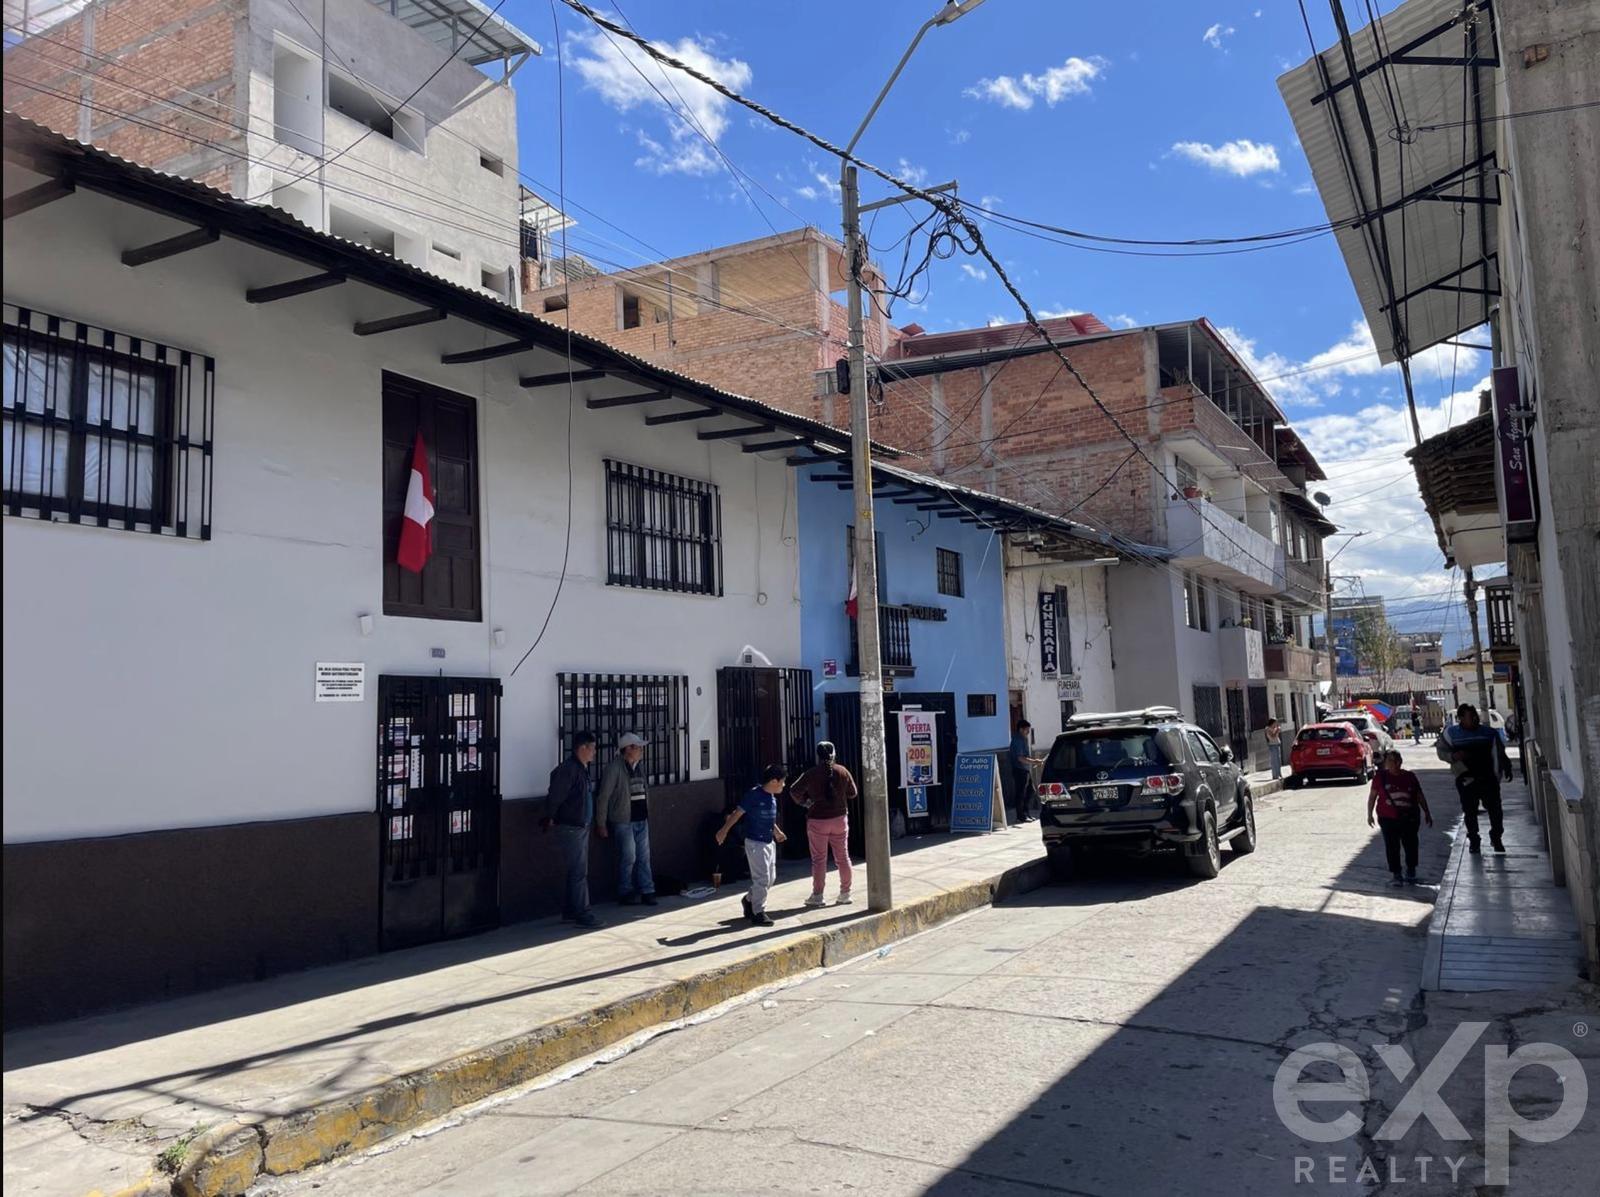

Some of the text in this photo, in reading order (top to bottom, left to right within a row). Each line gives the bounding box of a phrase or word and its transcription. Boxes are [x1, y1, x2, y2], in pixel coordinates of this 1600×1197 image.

[1508, 447, 1523, 472] San
[1042, 594, 1056, 671] FUNERARIA
[906, 723, 931, 733] OFERTA
